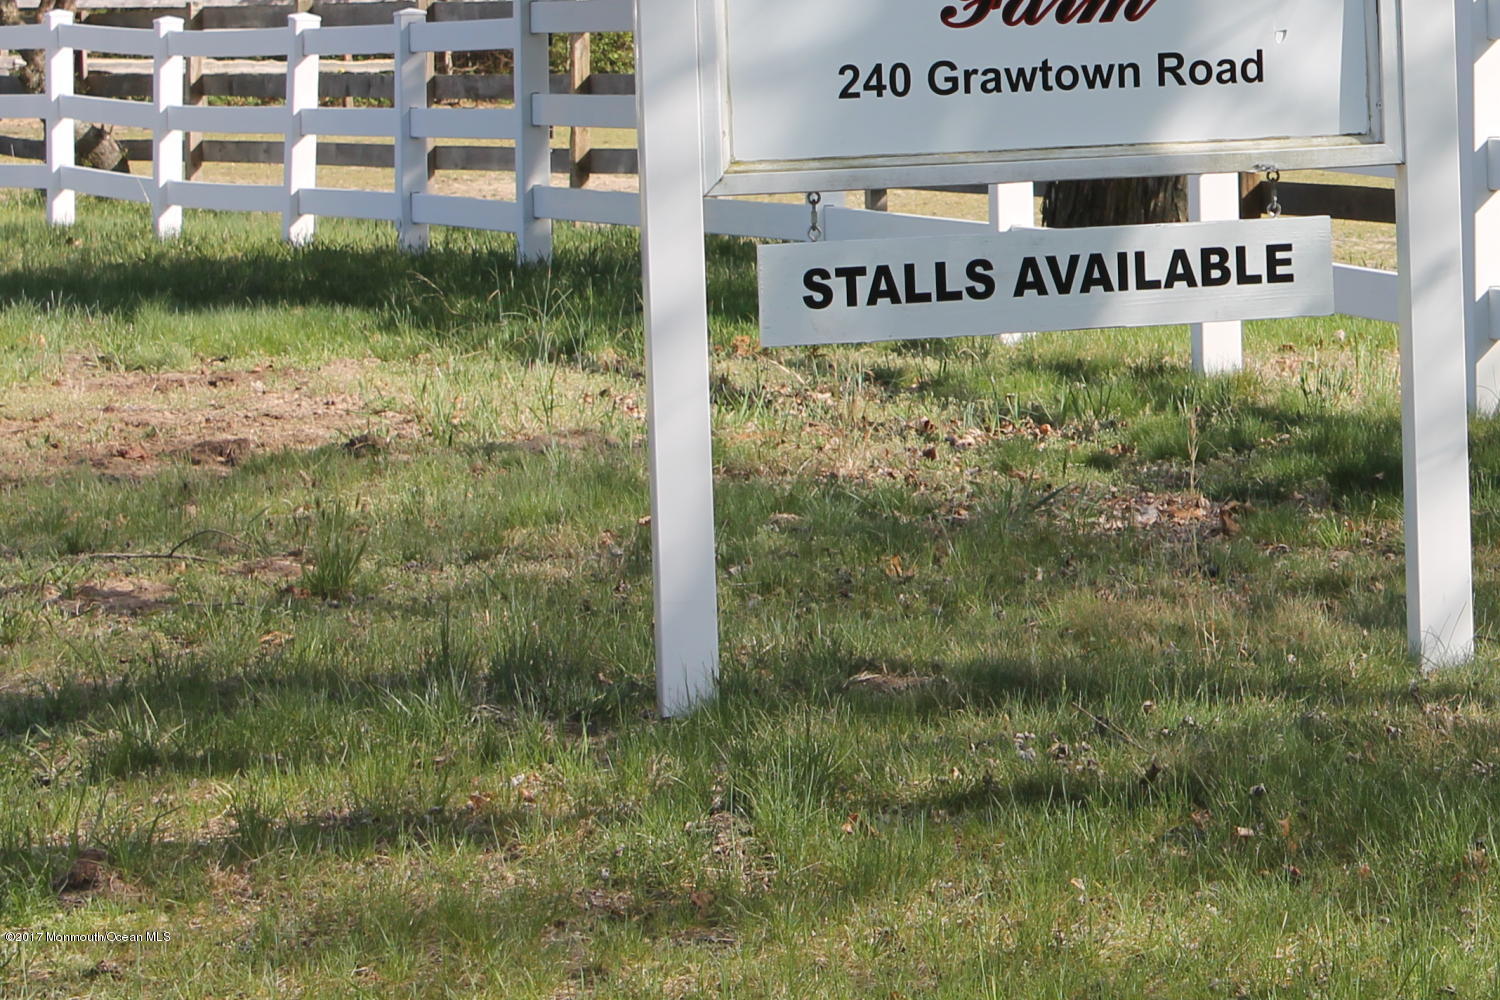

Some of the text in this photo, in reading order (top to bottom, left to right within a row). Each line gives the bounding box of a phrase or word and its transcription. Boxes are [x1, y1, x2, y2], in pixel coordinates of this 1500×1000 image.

[838, 49, 1264, 100] 240 Grawtown Road
[802, 243, 1295, 310] STALLS AVAILABLE
